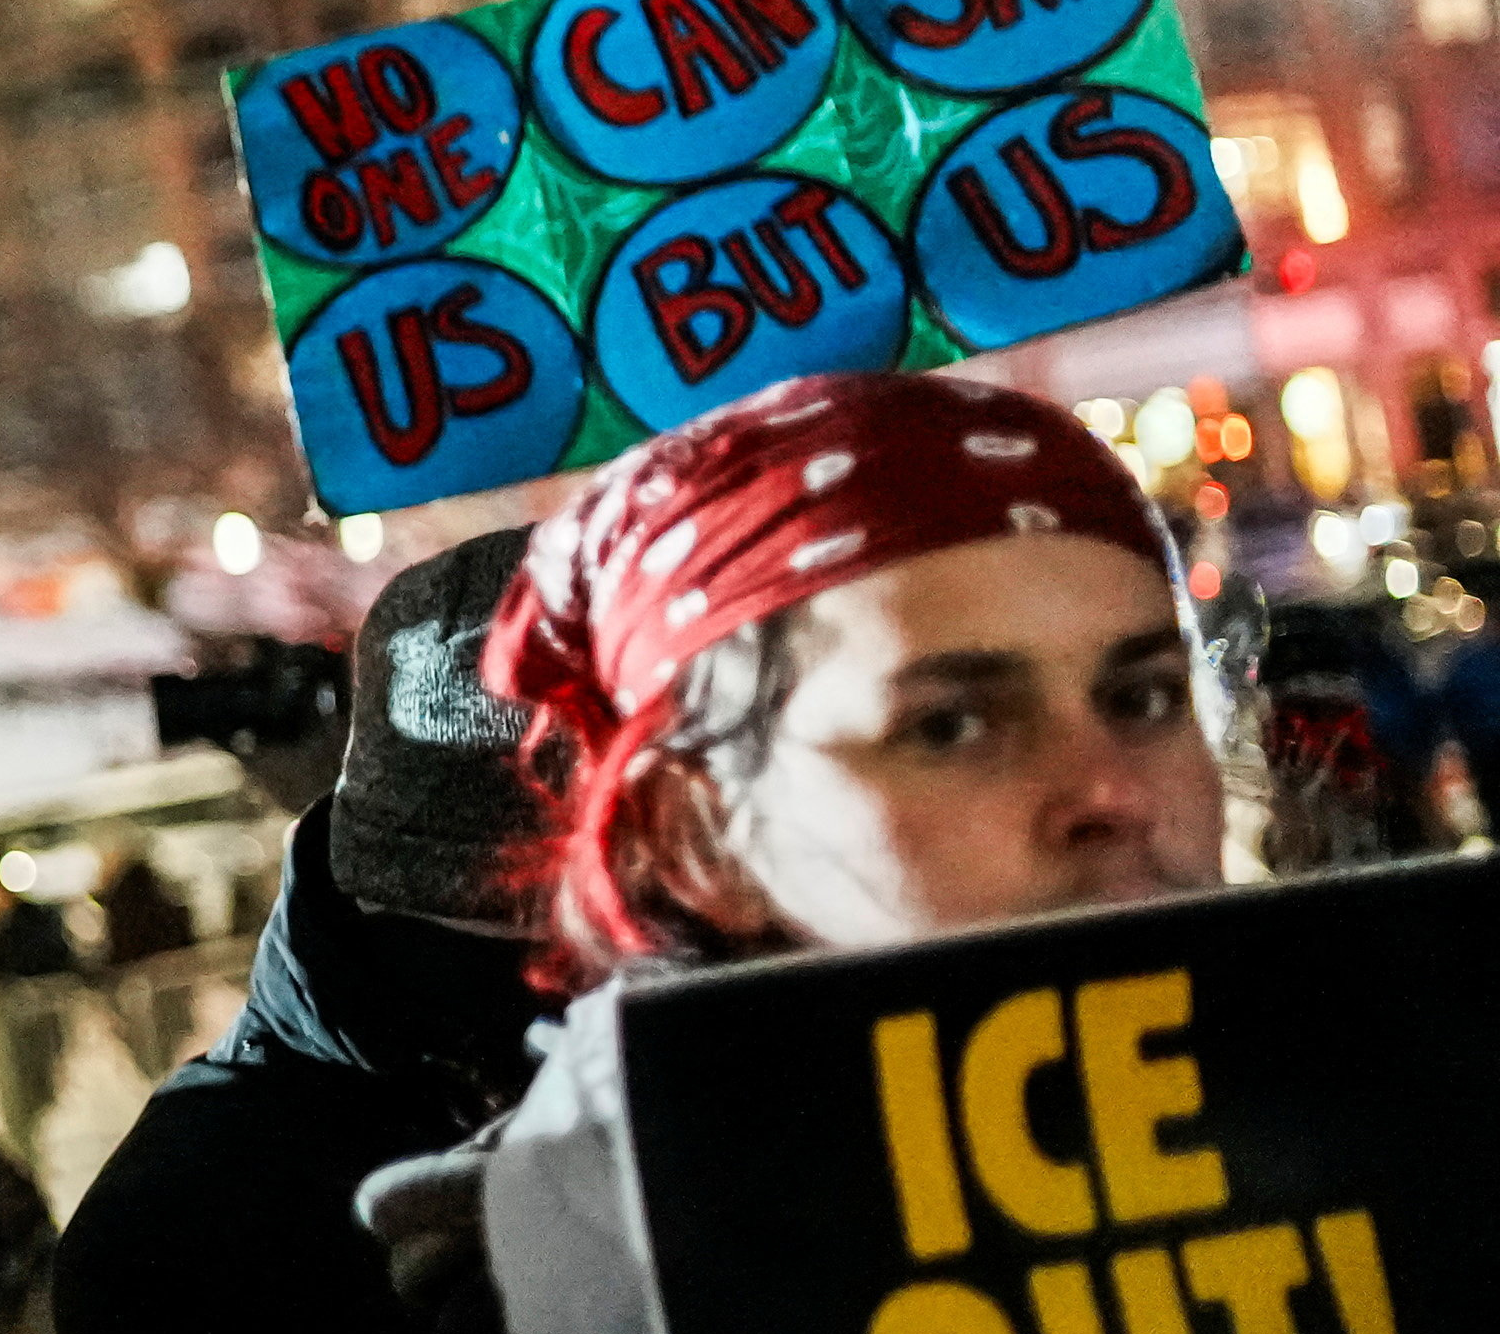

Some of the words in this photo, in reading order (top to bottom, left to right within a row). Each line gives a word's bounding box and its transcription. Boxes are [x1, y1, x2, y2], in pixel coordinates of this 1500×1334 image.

[280, 44, 436, 164] NO
[304, 113, 496, 250] ONE
[337, 283, 533, 466] US
[630, 183, 868, 385] BUT
[946, 89, 1197, 279] US
[872, 968, 1230, 1261] ICE
